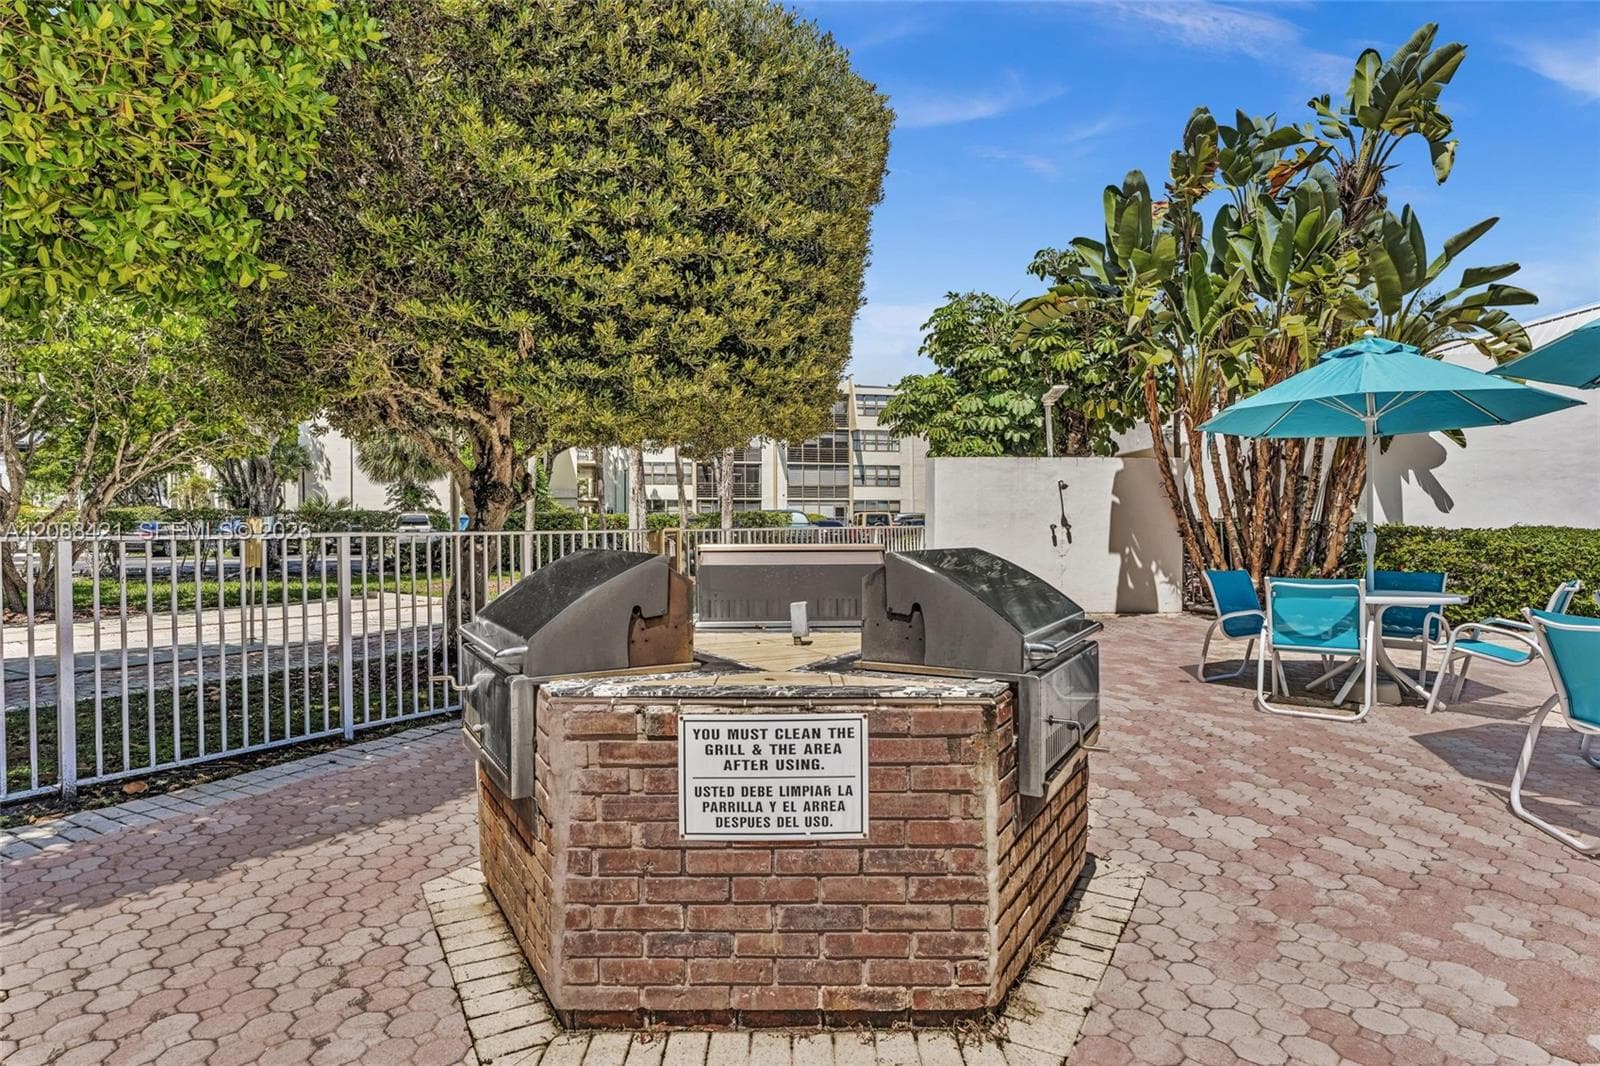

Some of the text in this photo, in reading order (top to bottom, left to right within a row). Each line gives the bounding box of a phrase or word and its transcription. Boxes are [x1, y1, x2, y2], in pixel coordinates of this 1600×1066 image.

[692, 726, 856, 741] YOU MUST CLEAN THE
[704, 742, 842, 756] GRILL & THE AREA
[723, 758, 825, 771] AFTER USING.
[694, 784, 854, 798] USTED DEBE LIMPIAR LA
[702, 800, 846, 813] PARRILLA Y EL ARREA
[715, 815, 833, 829] DESPUES DEL USO.
